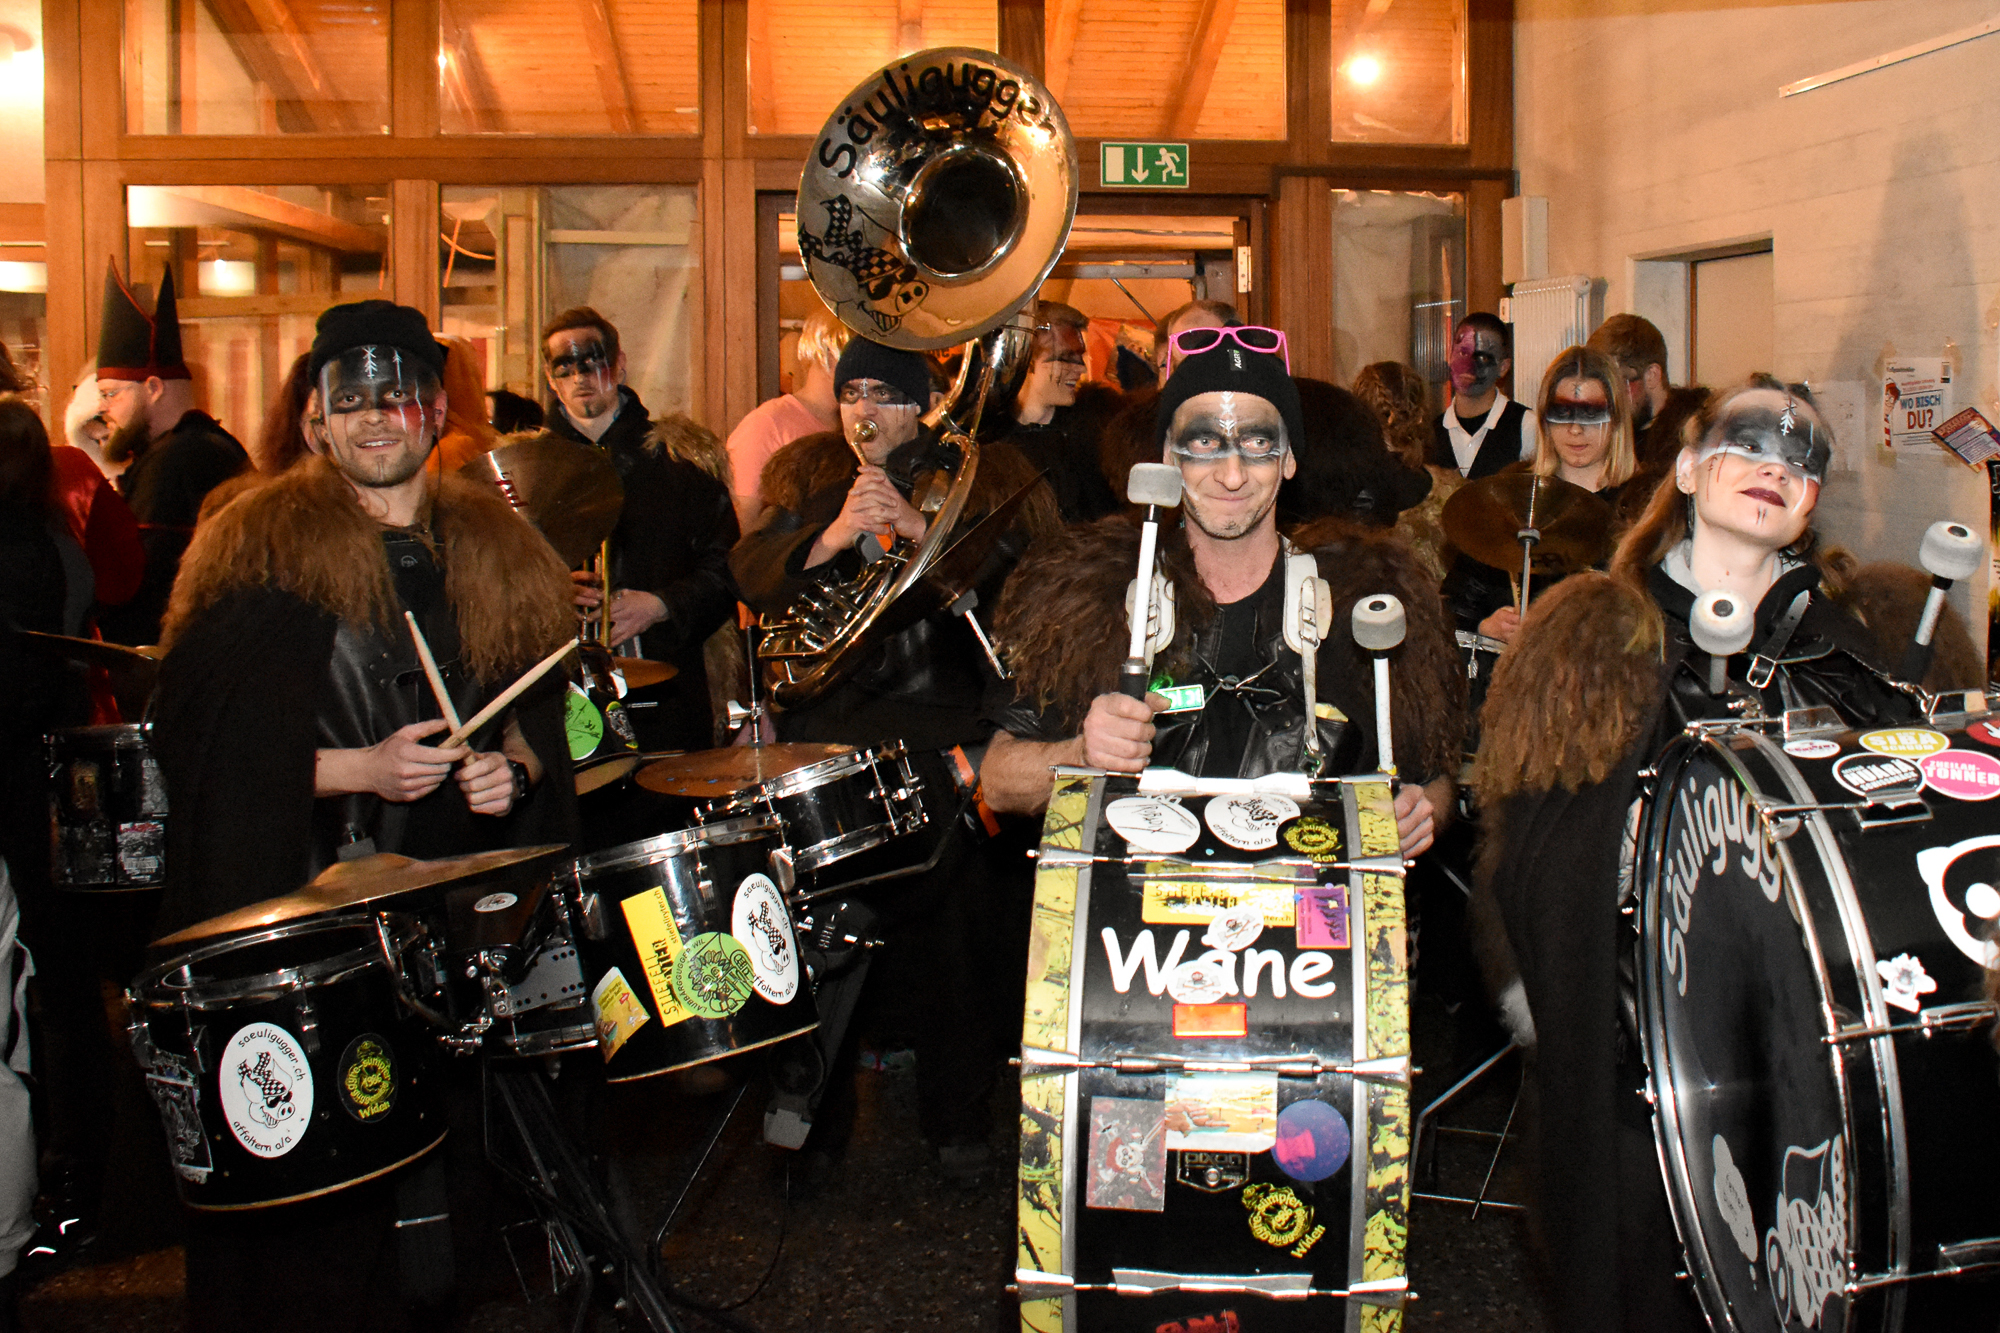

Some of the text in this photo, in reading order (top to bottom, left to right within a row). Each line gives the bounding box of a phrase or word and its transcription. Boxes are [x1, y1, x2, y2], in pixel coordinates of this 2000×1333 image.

[1900, 394, 1941, 410] WO BISCH
[1907, 408, 1934, 430] DU?
[1924, 765, 2000, 786] TONNER
[1663, 776, 1811, 997] Säuligugg
[692, 938, 706, 951] WIL
[754, 973, 784, 998] ffoltern
[238, 1028, 307, 1081] saeuligugger.ch
[358, 1101, 391, 1119] Widen
[233, 1121, 292, 1152] affoltern a/a
[1290, 1224, 1326, 1259] Widen
